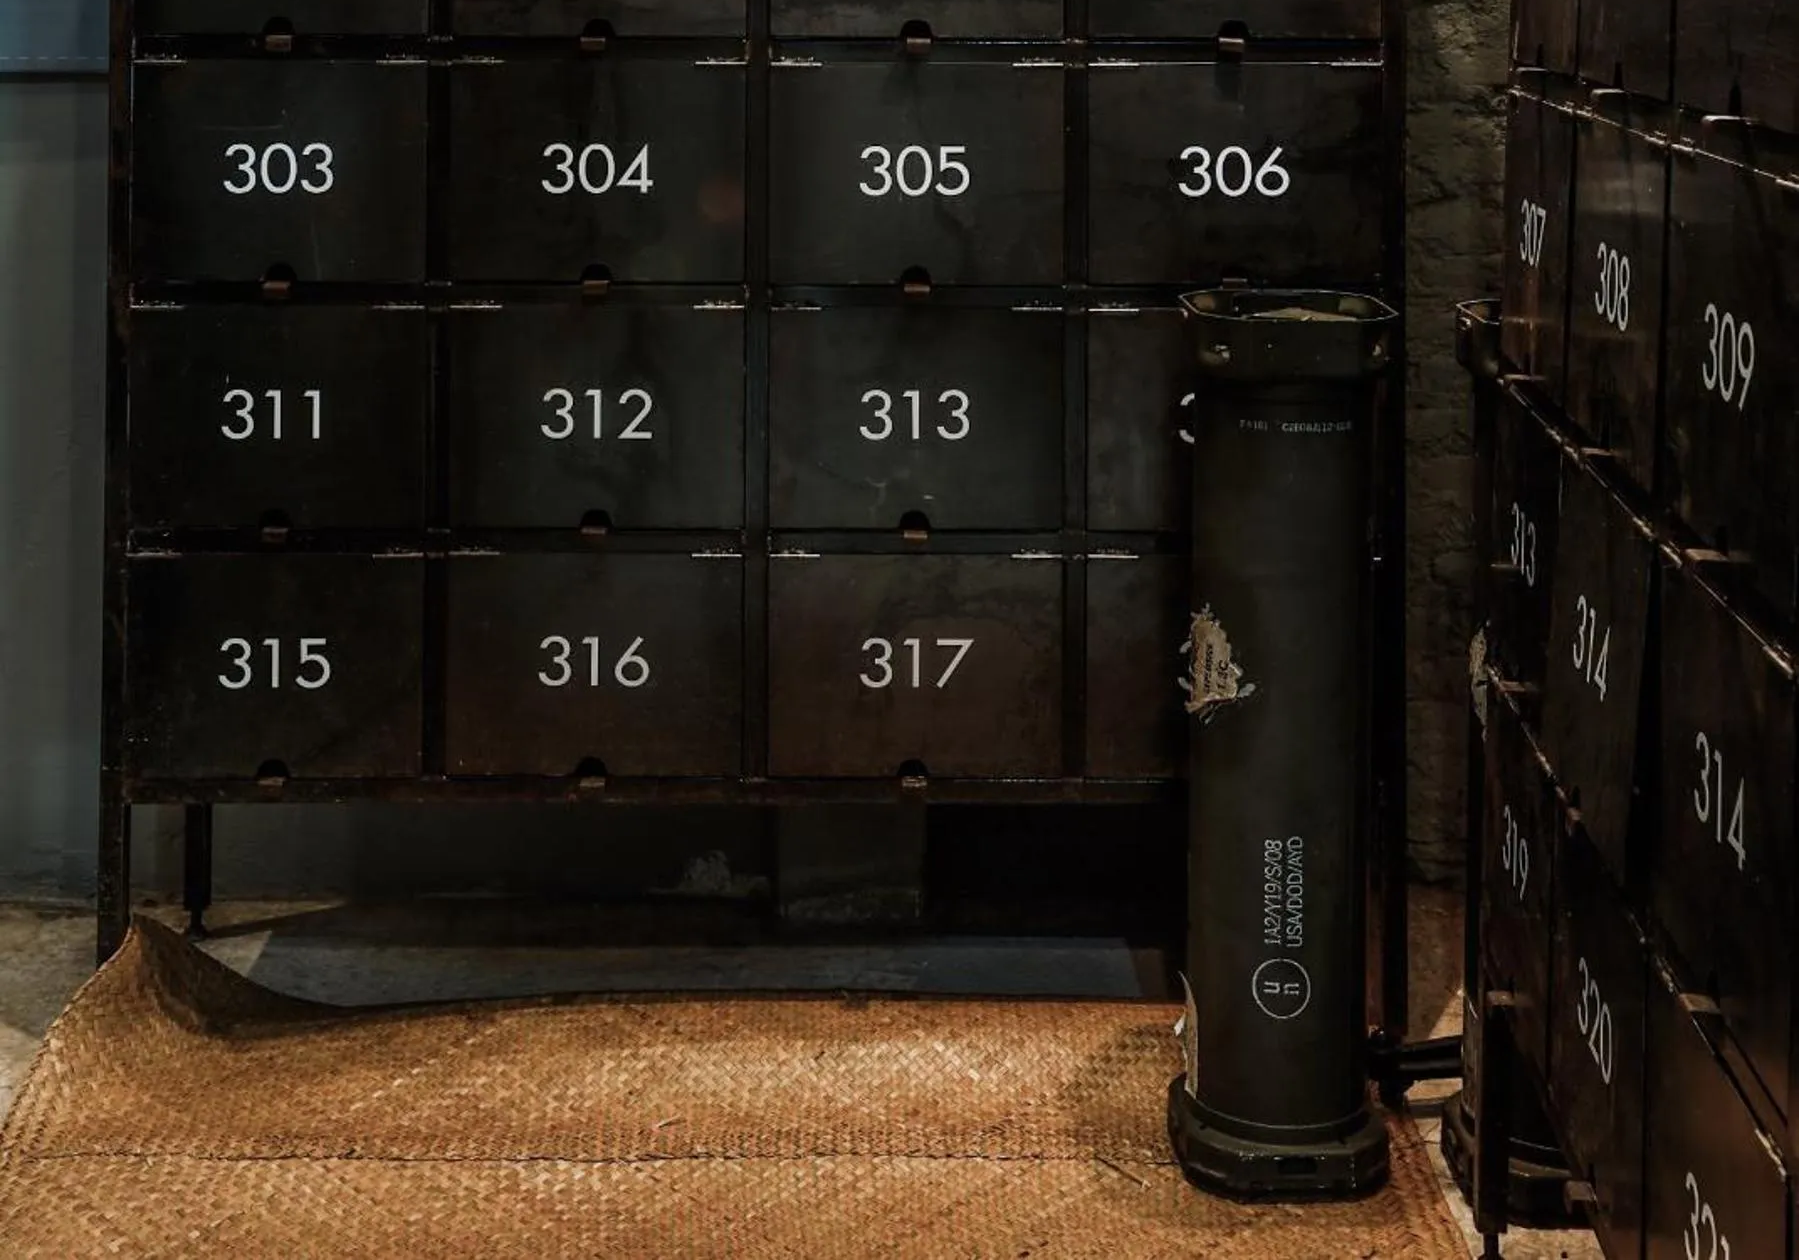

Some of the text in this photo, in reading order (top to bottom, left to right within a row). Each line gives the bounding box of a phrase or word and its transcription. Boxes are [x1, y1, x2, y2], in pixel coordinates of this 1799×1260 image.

[223, 142, 334, 194] 303
[541, 143, 654, 194] 304
[859, 145, 970, 197] 305
[1178, 145, 1290, 197] 306
[1519, 197, 1547, 267] 307
[1594, 242, 1631, 332] 308
[1702, 302, 1756, 412] 309
[221, 389, 320, 440] 311
[541, 388, 653, 439] 312
[859, 389, 970, 441] 313
[1510, 502, 1537, 588] 313
[219, 638, 331, 689] 315
[538, 635, 650, 687] 316
[860, 637, 974, 688] 317
[1572, 594, 1611, 702] 314
[1693, 731, 1747, 871] 314
[1501, 803, 1530, 901] 319
[1285, 835, 1304, 948] USA/DOD/AYD
[1576, 956, 1614, 1085] 320
